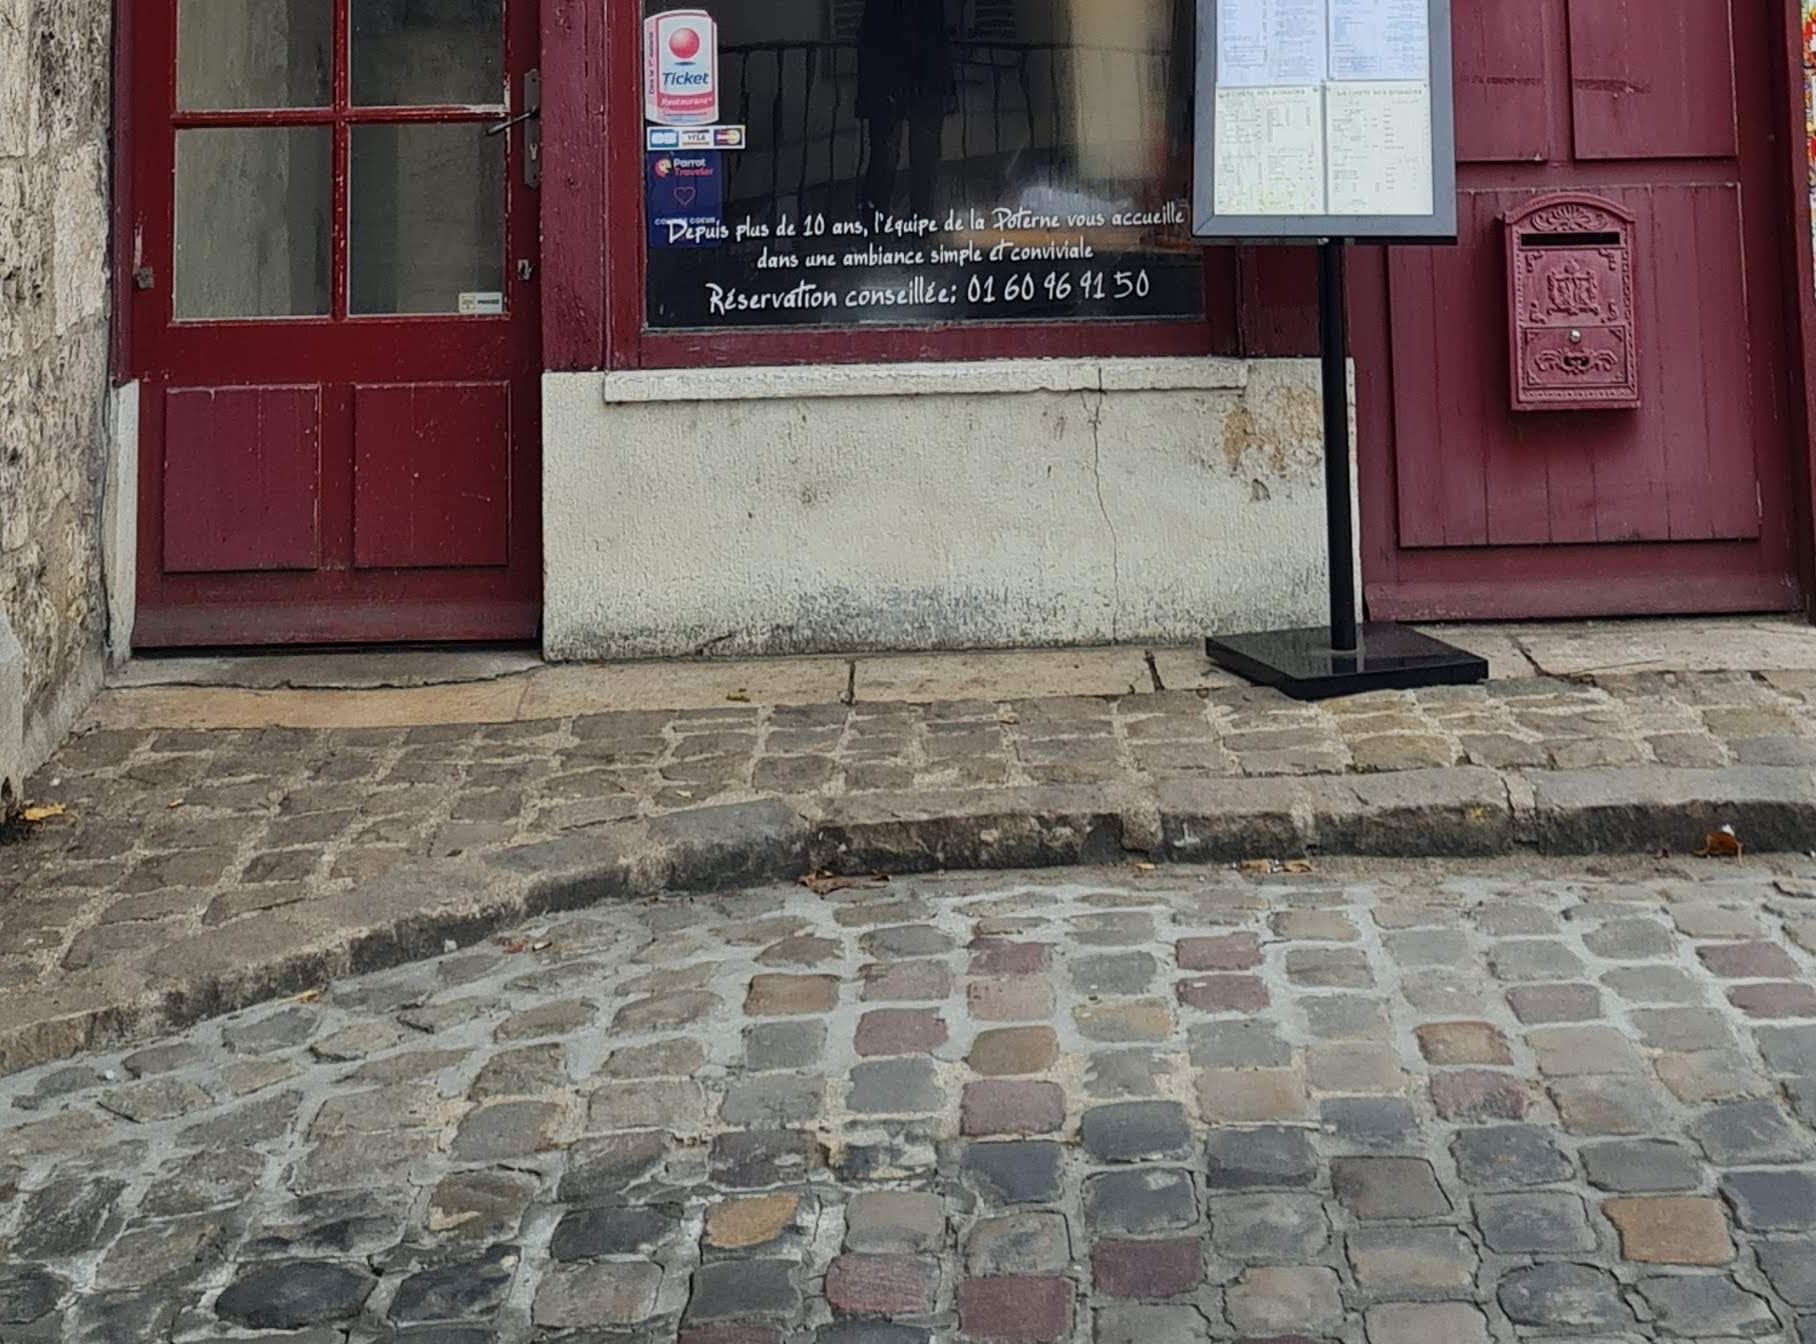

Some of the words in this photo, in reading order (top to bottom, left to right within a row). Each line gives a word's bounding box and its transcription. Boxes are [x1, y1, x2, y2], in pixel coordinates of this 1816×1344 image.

[662, 72, 709, 85] Ticket
[673, 158, 706, 167] Parrot
[666, 218, 729, 243] Depuis
[735, 215, 769, 242] plus
[775, 213, 796, 236] de
[802, 213, 825, 236] 10
[832, 220, 869, 237] ans,
[874, 210, 938, 237] l'équipe
[944, 209, 964, 231] de
[970, 208, 985, 230] la
[991, 207, 1060, 230] Poterne
[1067, 211, 1105, 227] vous
[1112, 202, 1184, 226] accueille
[757, 246, 799, 269] dans
[805, 252, 836, 266] une
[843, 242, 925, 266] ambiance
[931, 241, 983, 266] simple
[989, 238, 1014, 261] et
[1010, 236, 1094, 261] conviviale
[705, 279, 838, 316] Réservation
[967, 274, 996, 303] 01
[1004, 273, 1035, 301] 60
[1043, 271, 1072, 300] 96
[1080, 270, 1105, 300] 91
[1113, 269, 1150, 299] 50
